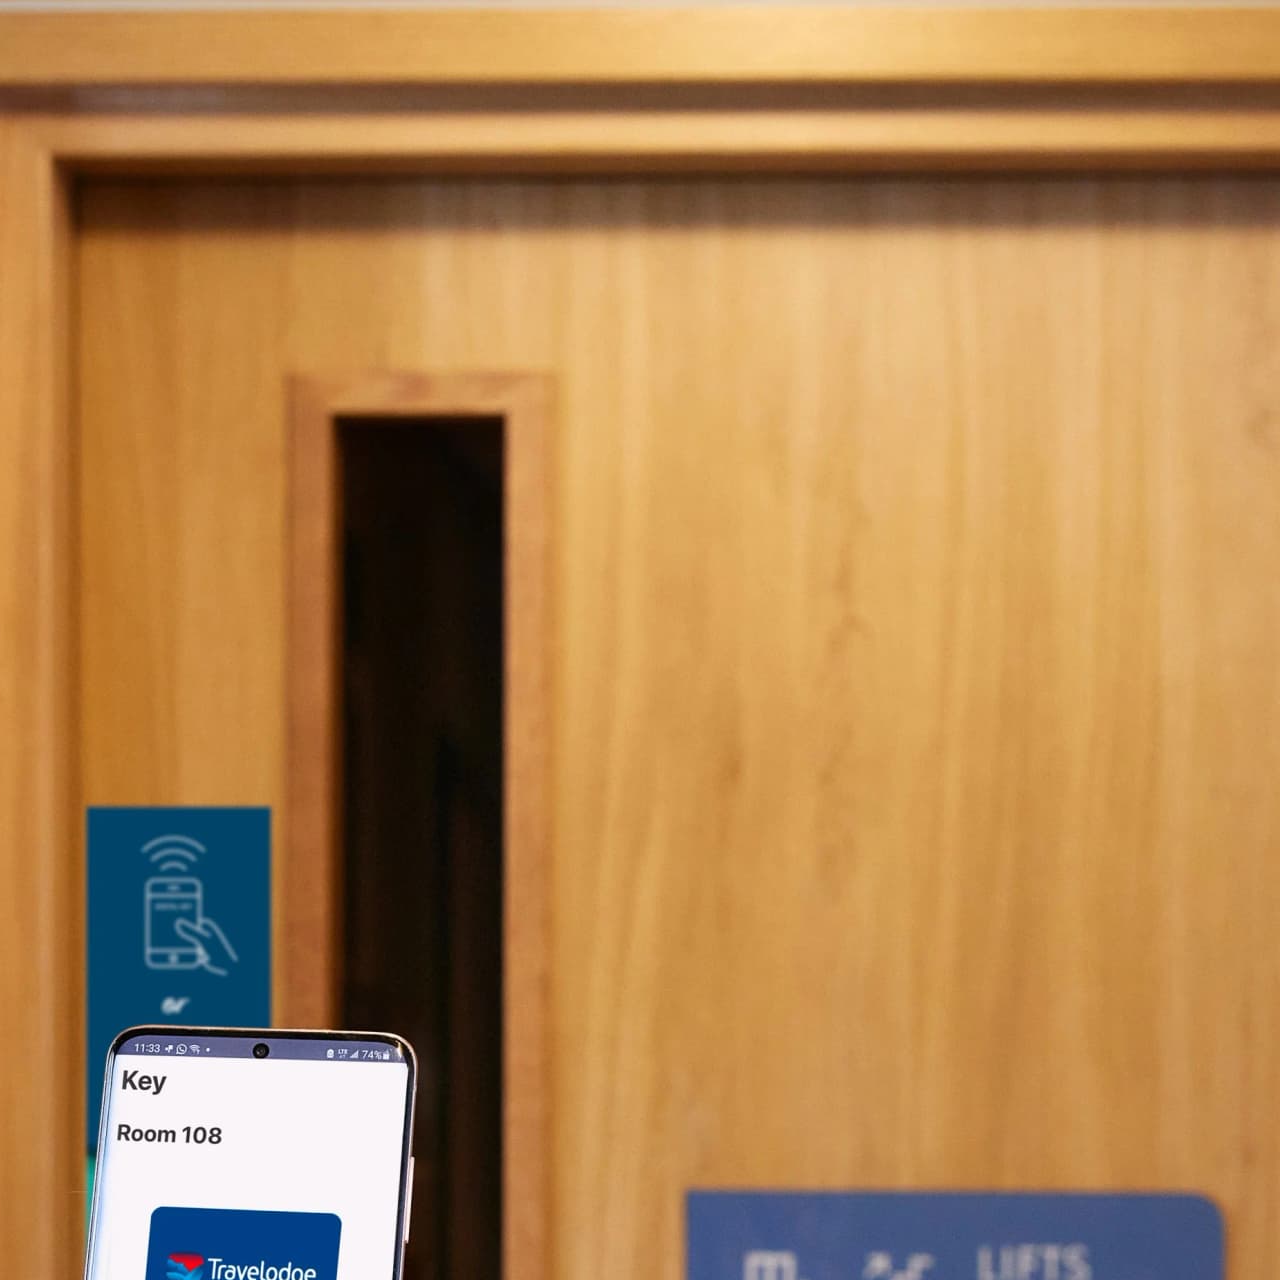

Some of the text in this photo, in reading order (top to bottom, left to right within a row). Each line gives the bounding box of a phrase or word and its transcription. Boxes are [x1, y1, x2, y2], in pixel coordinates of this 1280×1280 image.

[135, 1043, 160, 1053] 11:33
[362, 1050, 382, 1060] 74%
[121, 1069, 167, 1095] Key
[116, 1124, 222, 1144] Room 108
